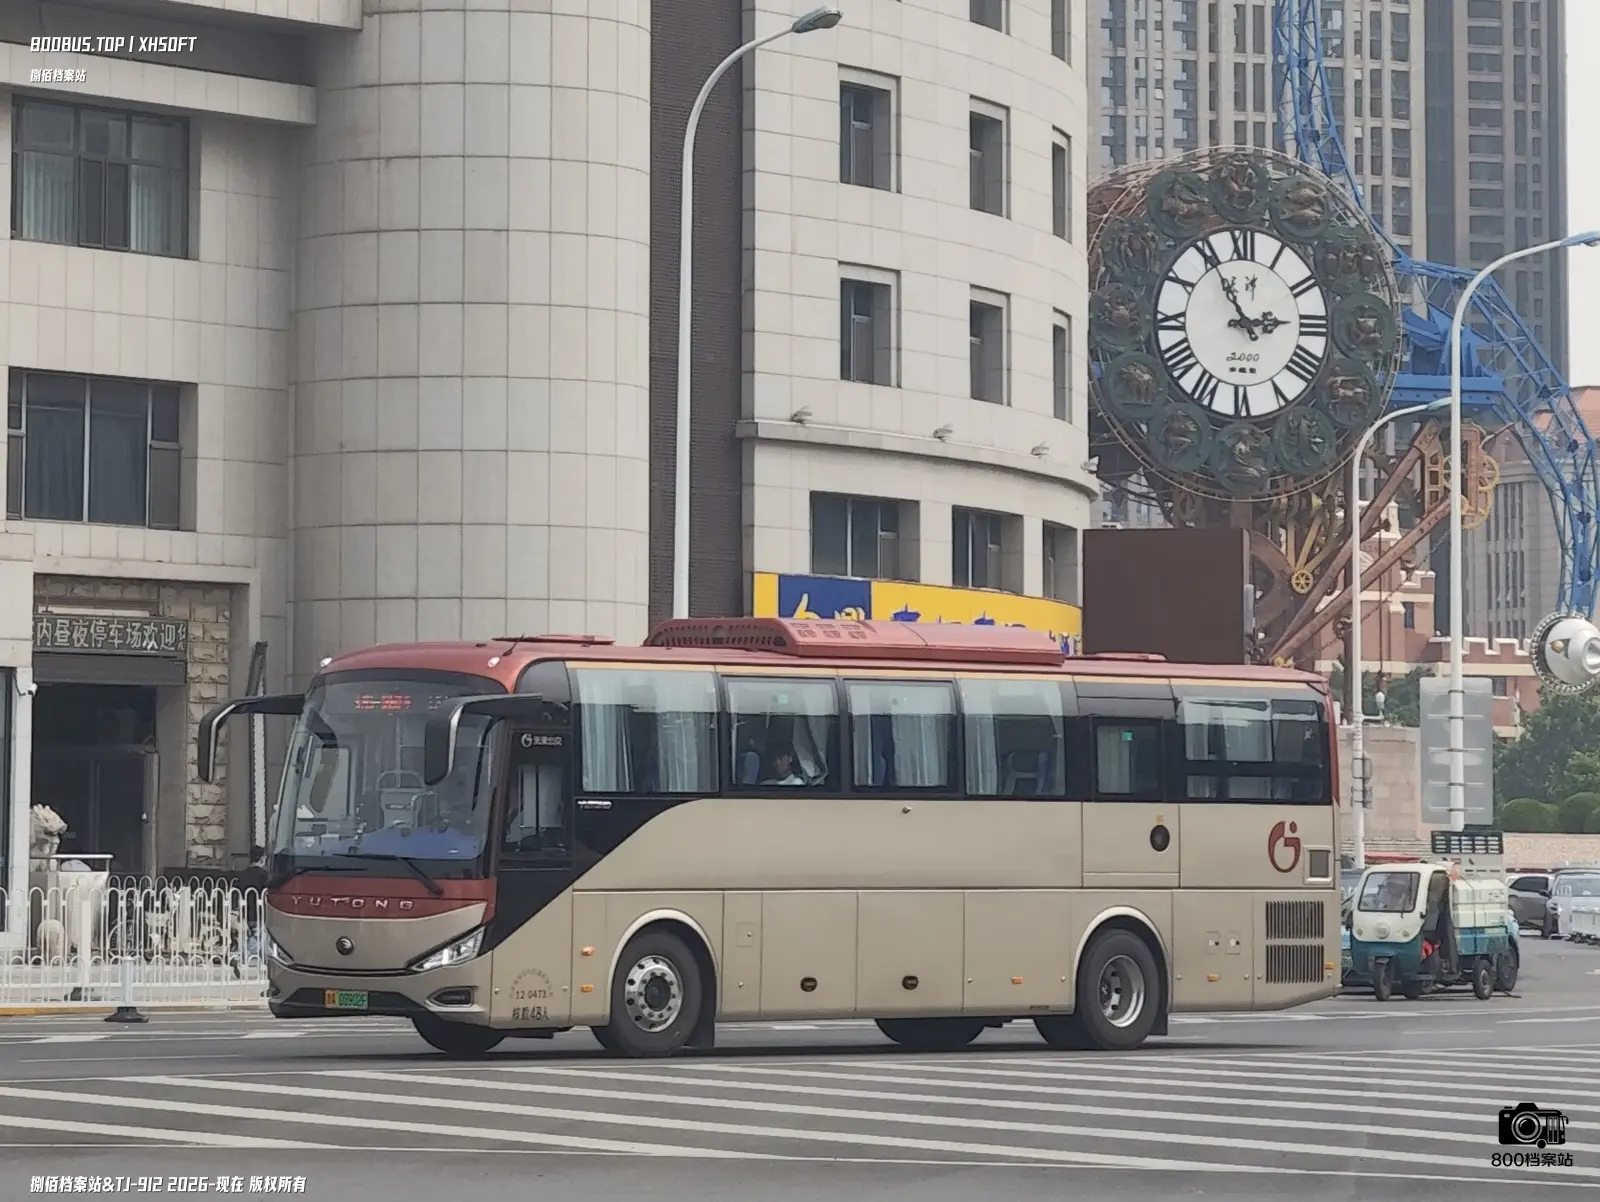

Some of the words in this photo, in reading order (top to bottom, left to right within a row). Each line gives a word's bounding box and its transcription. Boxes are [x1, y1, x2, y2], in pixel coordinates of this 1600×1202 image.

[1226, 352, 1260, 362] 2000
[32, 618, 187, 651] 内昼夜停车场欢迎
[292, 896, 414, 910] YUTONG
